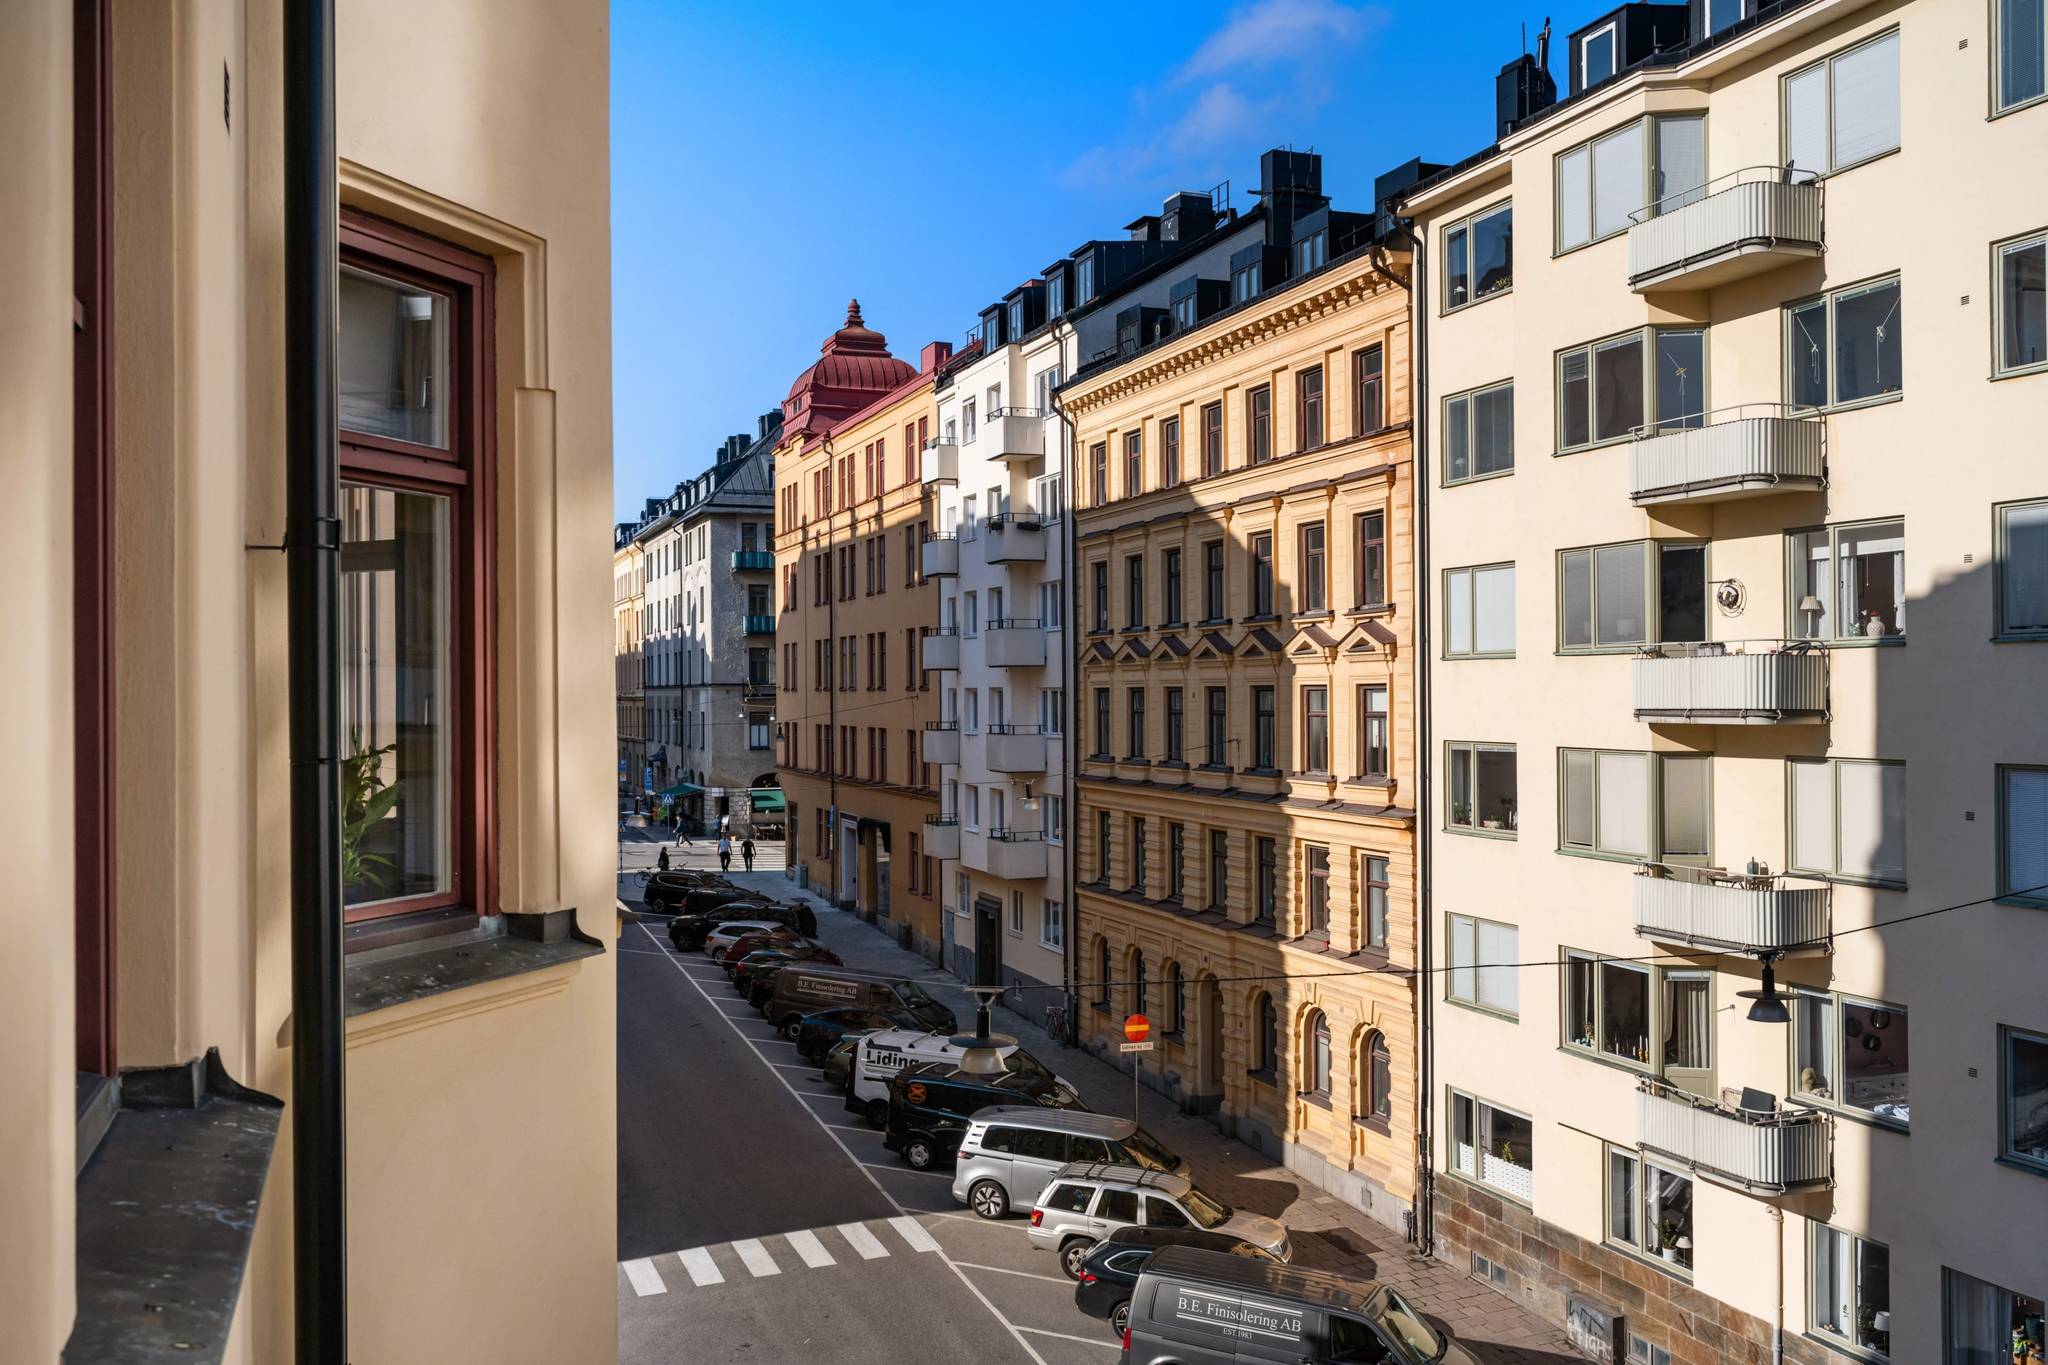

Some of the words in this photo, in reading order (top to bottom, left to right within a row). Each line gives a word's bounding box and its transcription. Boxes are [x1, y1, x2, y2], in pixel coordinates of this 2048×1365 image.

[1177, 1297, 1203, 1313] B.E.
[1207, 1302, 1278, 1331] Finisolering
[1280, 1318, 1302, 1332] AB
